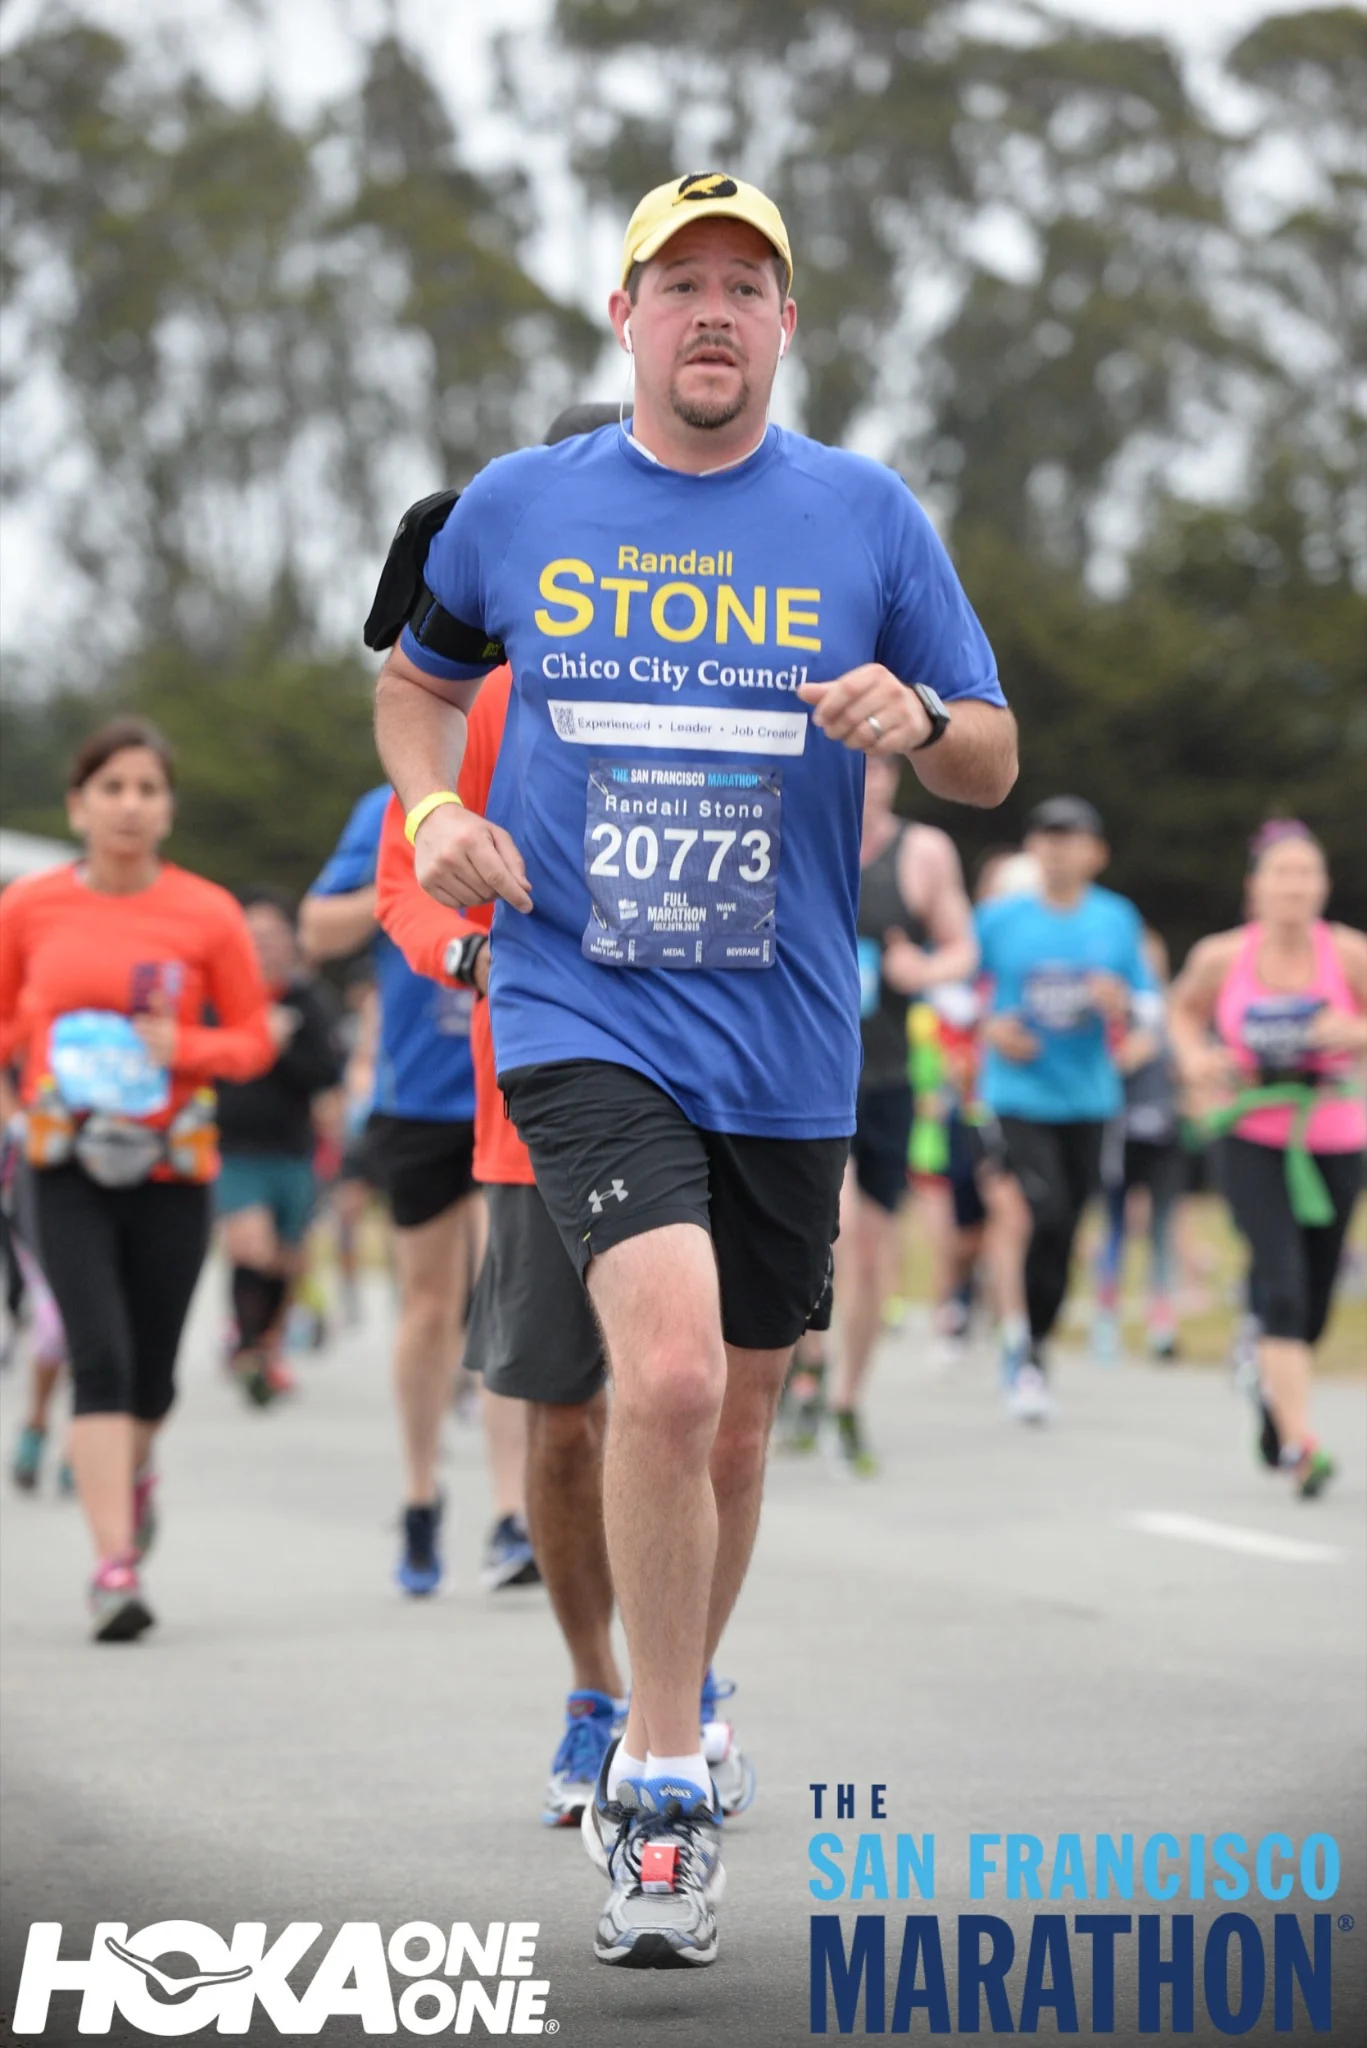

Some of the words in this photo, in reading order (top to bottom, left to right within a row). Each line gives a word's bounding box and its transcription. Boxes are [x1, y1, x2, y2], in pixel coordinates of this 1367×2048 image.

[618, 545, 733, 577] Randall
[534, 558, 822, 652] STONE
[542, 653, 620, 680] Chico
[629, 655, 690, 691] City
[698, 661, 808, 691] Council
[578, 717, 651, 731] Experienced
[670, 723, 713, 734] Leader
[732, 725, 754, 737] Job
[757, 727, 799, 740] Creator
[611, 768, 630, 783] THE
[630, 769, 650, 785] SAN
[651, 770, 706, 787] FRANCISCO
[707, 771, 760, 788] MARATHON
[605, 795, 688, 816] Randall
[699, 800, 764, 819] Stone
[589, 822, 771, 883] 20773
[663, 892, 689, 907] FULL
[716, 903, 737, 912] WAVE
[647, 906, 707, 922] MARATHON
[662, 947, 686, 957] MEDAL
[726, 947, 760, 957] BEVERAGE
